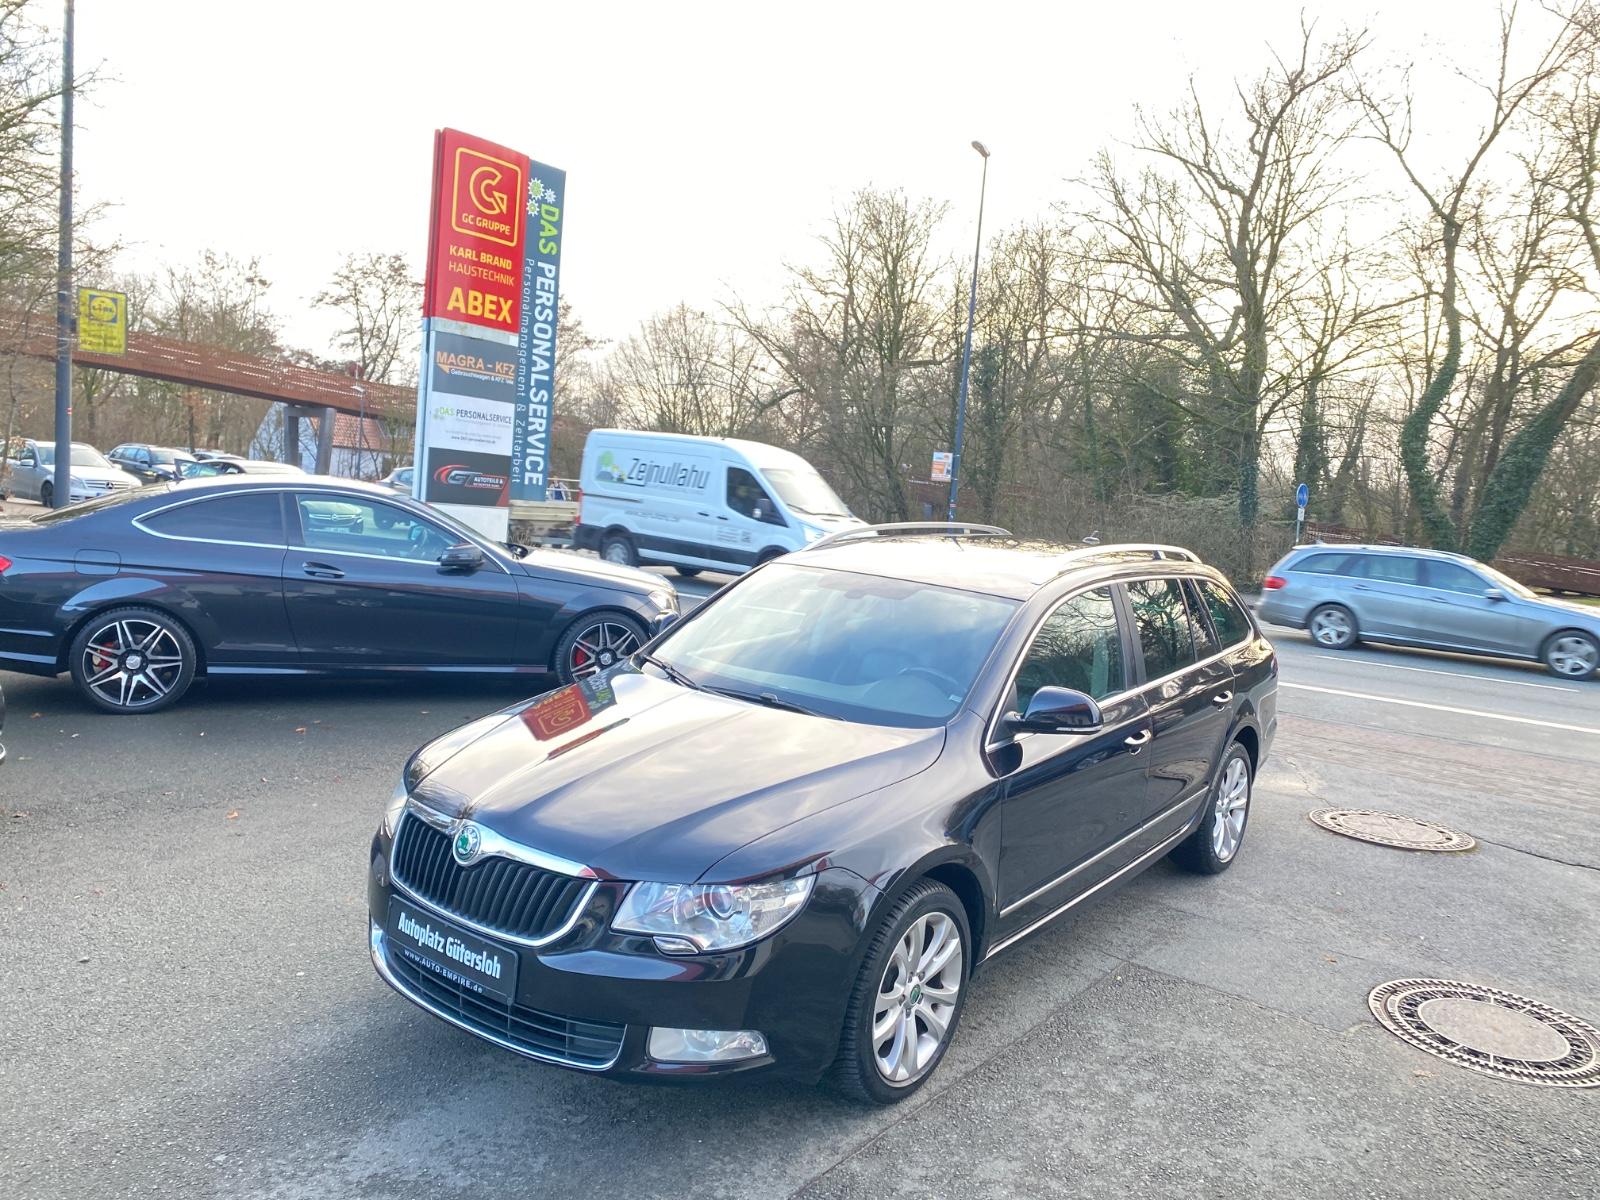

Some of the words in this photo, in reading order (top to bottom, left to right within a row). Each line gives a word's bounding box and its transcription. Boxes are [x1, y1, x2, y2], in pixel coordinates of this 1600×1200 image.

[462, 213, 475, 225] GC
[476, 217, 511, 235] GRUPPE
[538, 203, 560, 256] DAS
[448, 260, 515, 287] HAUSTECHNIK
[449, 244, 479, 261] KARL
[480, 252, 512, 270] BRAND
[447, 286, 513, 324] ABEX
[516, 258, 535, 396] Personalmanagement
[436, 351, 485, 370] MAGRA
[495, 361, 516, 377] KFZ
[524, 261, 556, 486] PERSONALSERVICE
[439, 406, 456, 416] DAS
[456, 408, 513, 425] PERSONALSERVICE
[516, 403, 526, 412] &
[511, 419, 526, 483] Zeitarbeit
[625, 457, 711, 489] Zejnullahu
[398, 911, 444, 954] Autoplatz
[445, 936, 501, 979] Gütersloh
[404, 948, 483, 994] www.AUTO-EMPIRE.de
